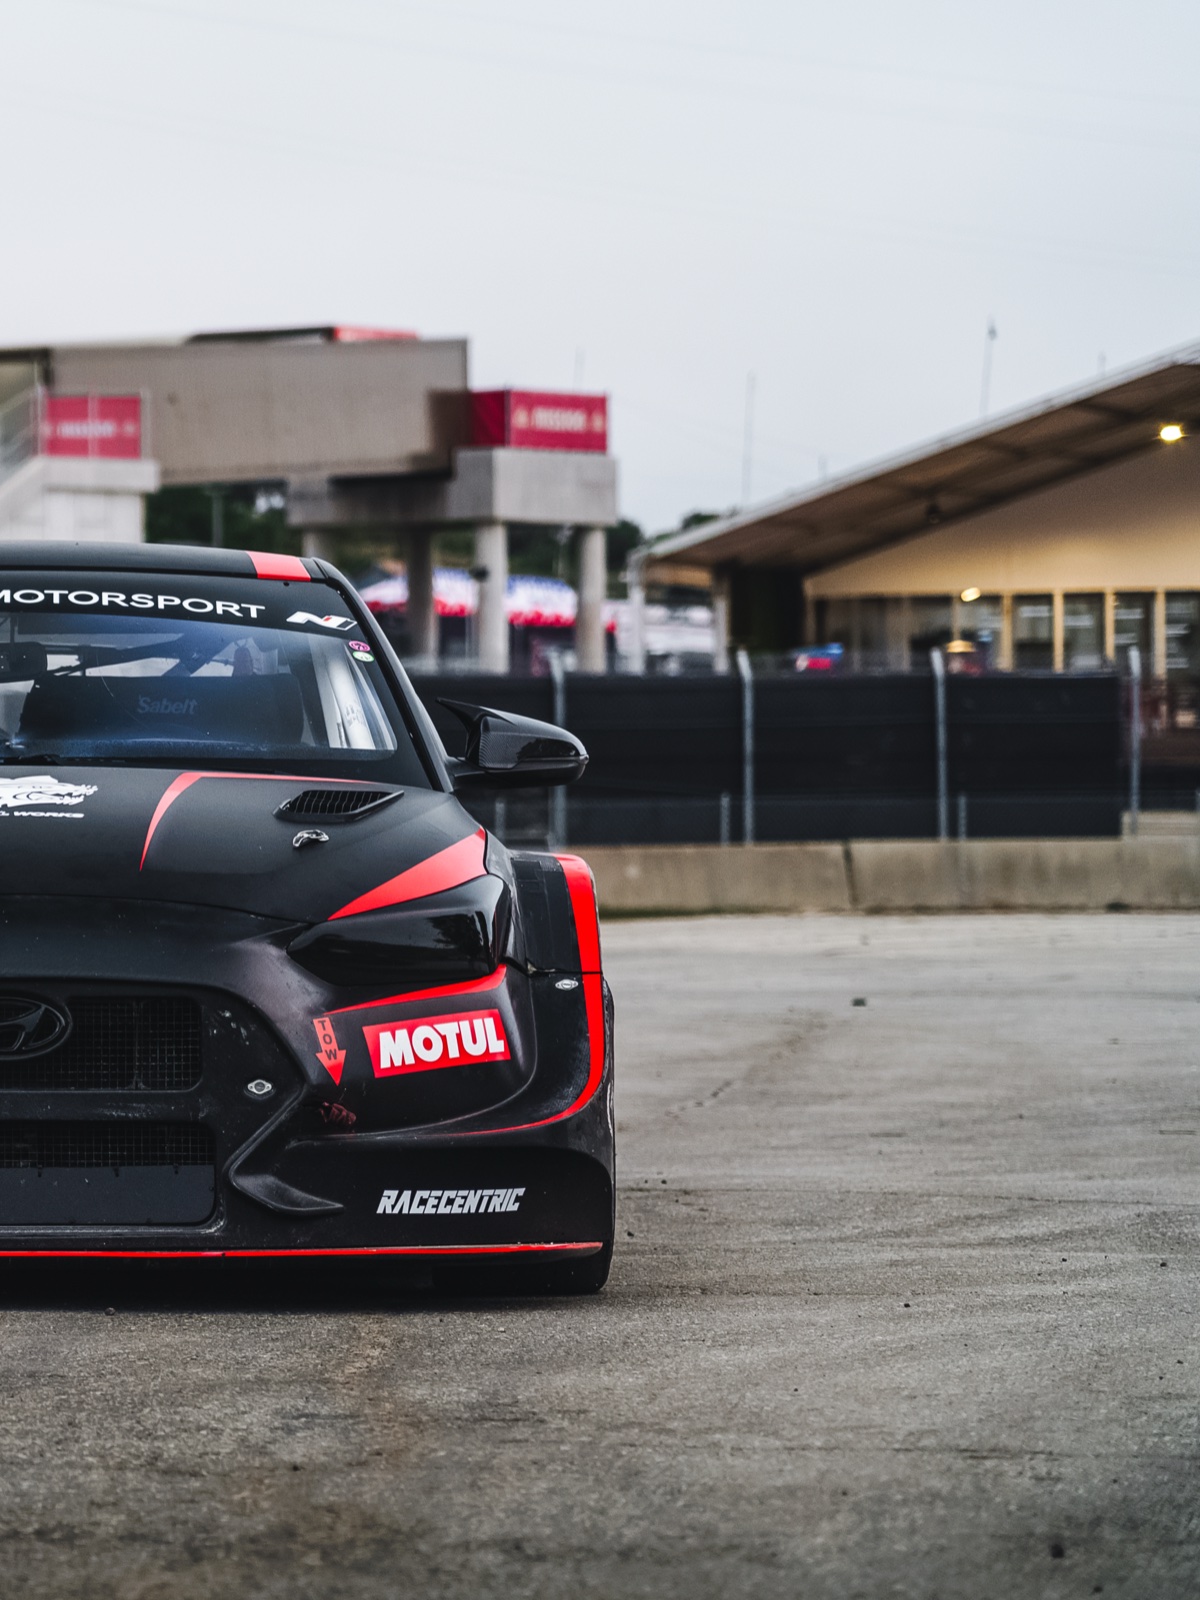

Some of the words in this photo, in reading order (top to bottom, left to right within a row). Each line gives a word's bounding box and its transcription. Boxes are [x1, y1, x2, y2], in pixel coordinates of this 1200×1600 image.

[137, 697, 198, 715] Sabelt
[318, 1020, 338, 1061] TOW
[379, 1017, 505, 1069] MOTUL
[376, 1188, 526, 1214] RACECENTRIC
